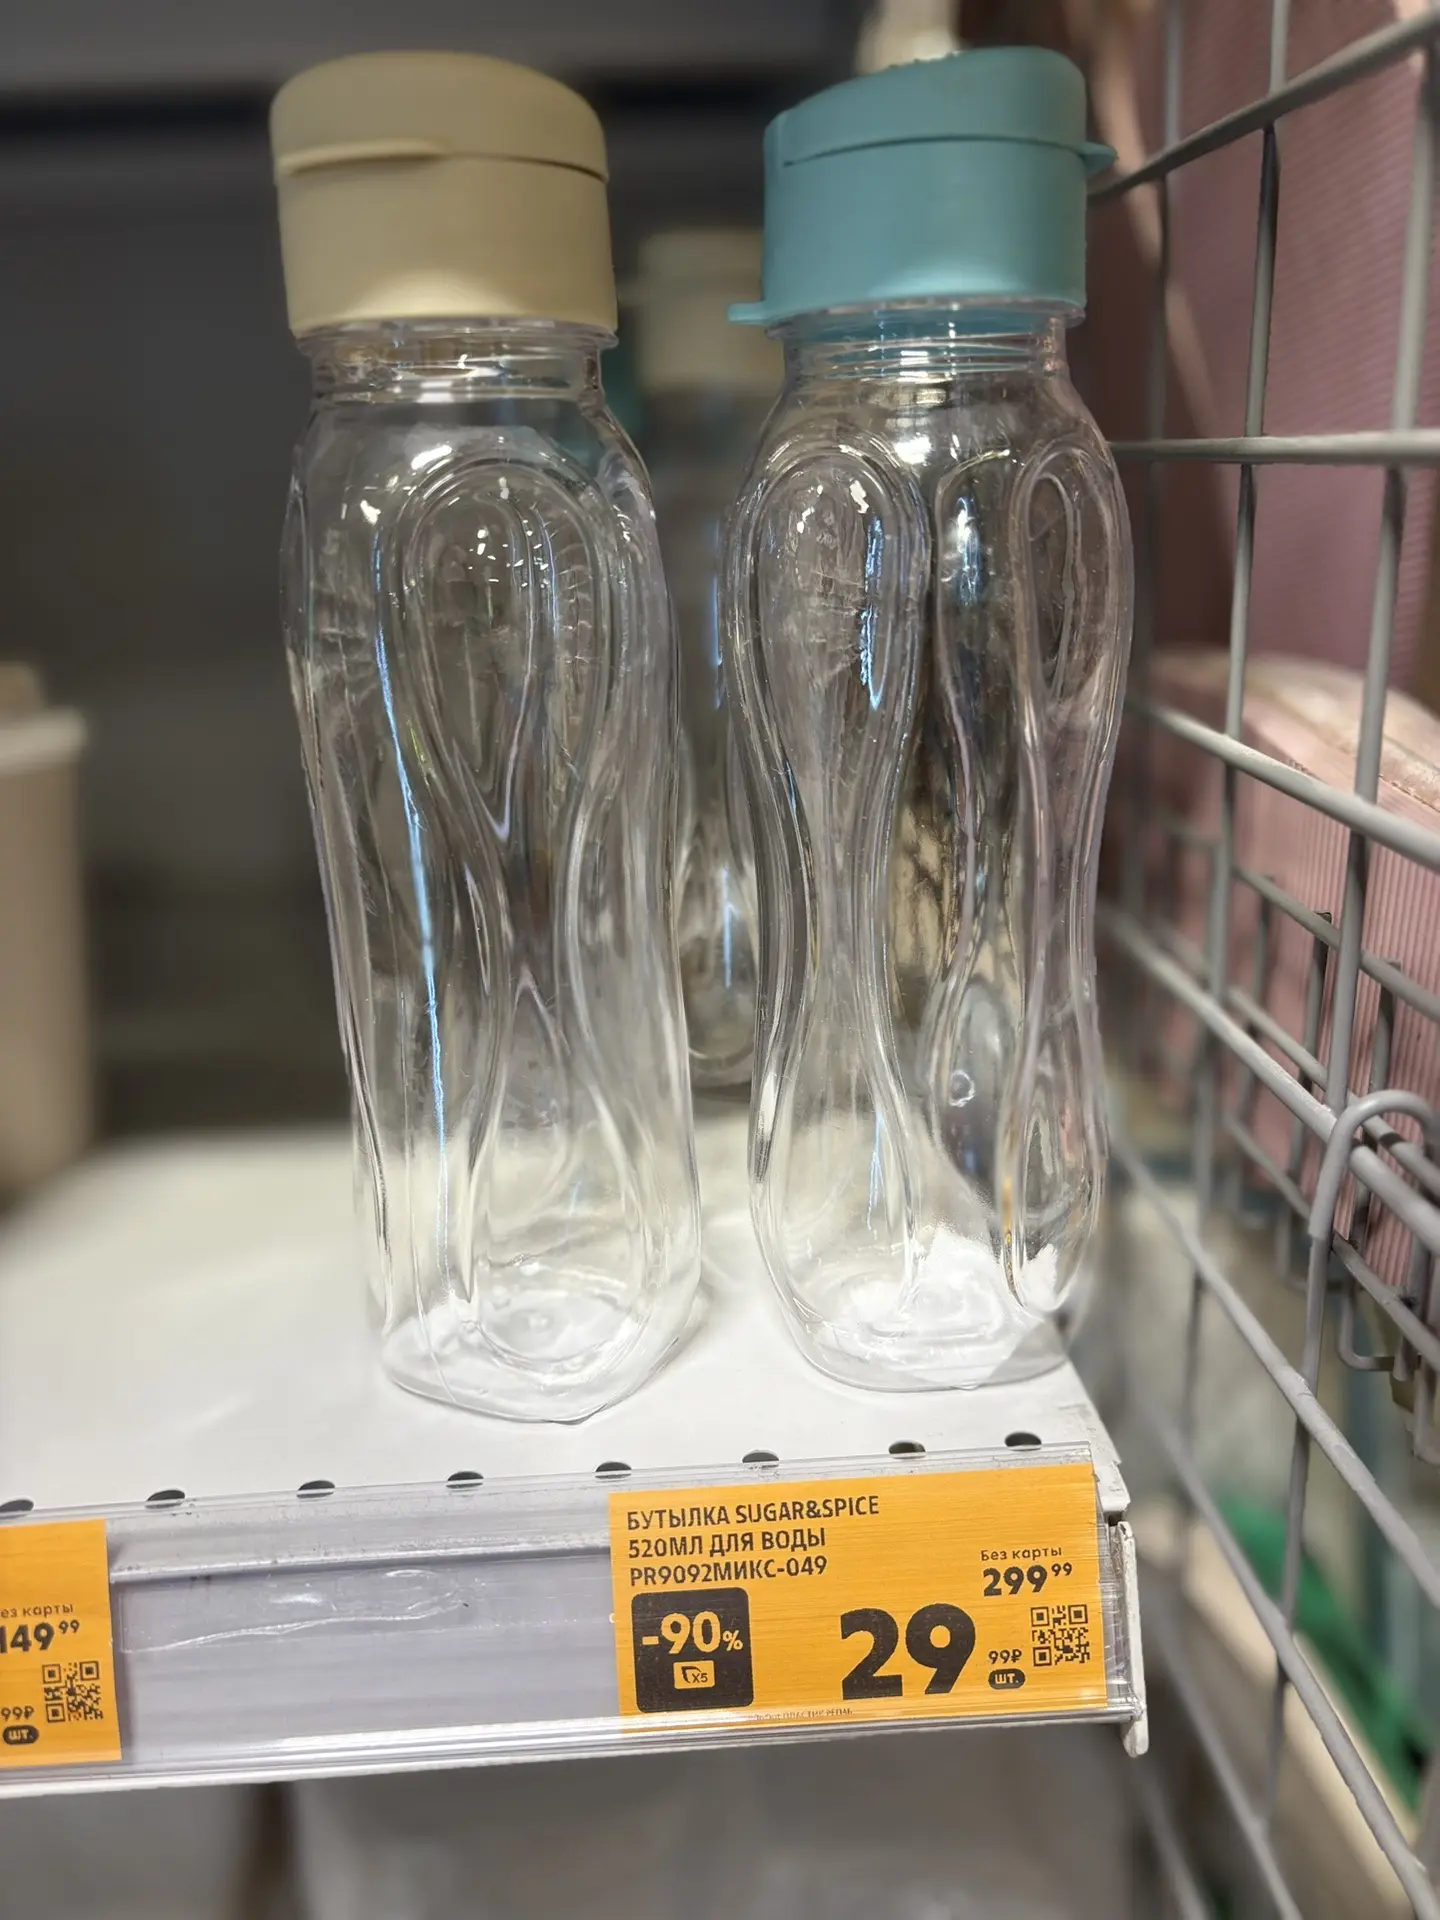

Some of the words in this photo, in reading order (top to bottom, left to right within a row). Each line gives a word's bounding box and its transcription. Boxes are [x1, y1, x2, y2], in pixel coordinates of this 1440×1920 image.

[628, 1505, 730, 1530] БУТЫЛКА
[736, 1495, 880, 1524] SUGAR&SPICE
[628, 1535, 703, 1558] 520МЛ
[709, 1532, 754, 1556] ДЛЯ
[762, 1527, 826, 1551] ВОДЫ
[981, 1549, 1008, 1561] Без
[1012, 1547, 1063, 1561] карты
[630, 1555, 828, 1586] PR9092МИКС-049
[983, 1564, 1048, 1597] 299
[1051, 1562, 1073, 1577] 99
[0, 1608, 17, 1619] ез
[23, 1604, 74, 1618] карты
[58, 1619, 80, 1635] 99
[642, 1610, 743, 1655] -90%
[840, 1602, 977, 1701] 29
